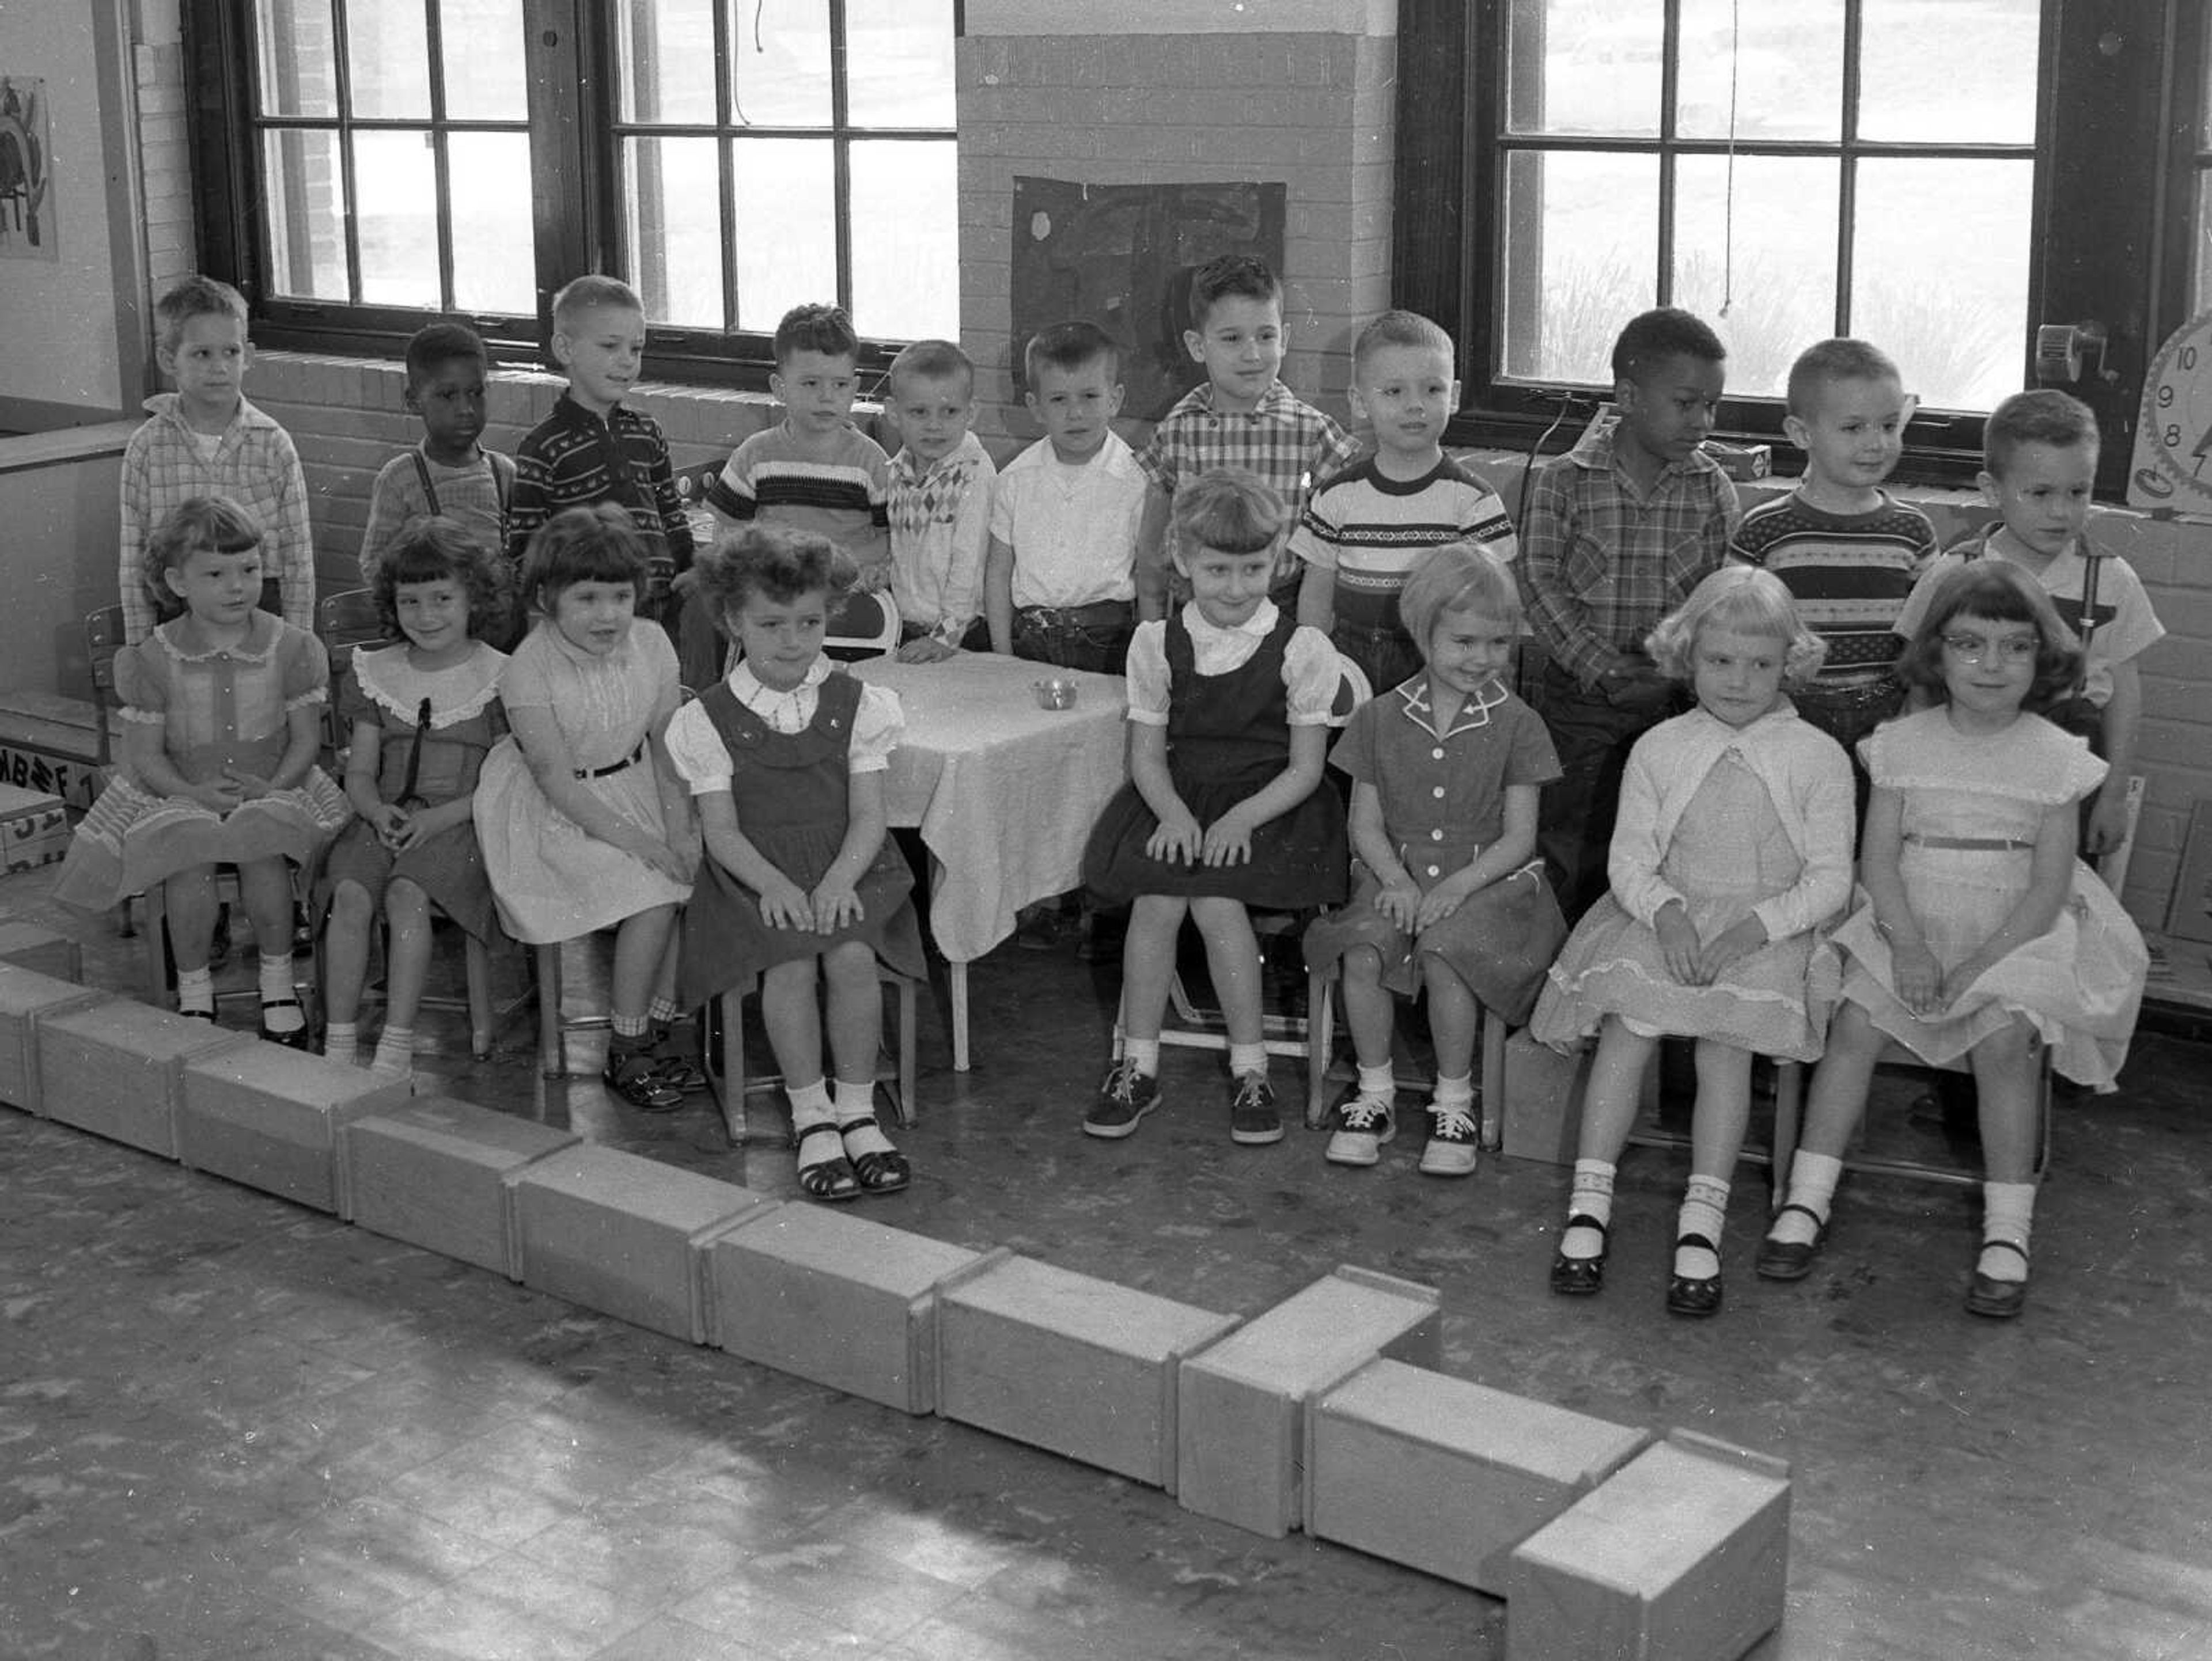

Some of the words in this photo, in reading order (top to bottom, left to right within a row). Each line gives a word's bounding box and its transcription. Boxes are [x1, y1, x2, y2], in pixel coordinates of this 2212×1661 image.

[2177, 347, 2197, 371] 10
[2157, 385, 2173, 408] 9
[2164, 423, 2181, 447] 8
[2192, 453, 2207, 477] 7
